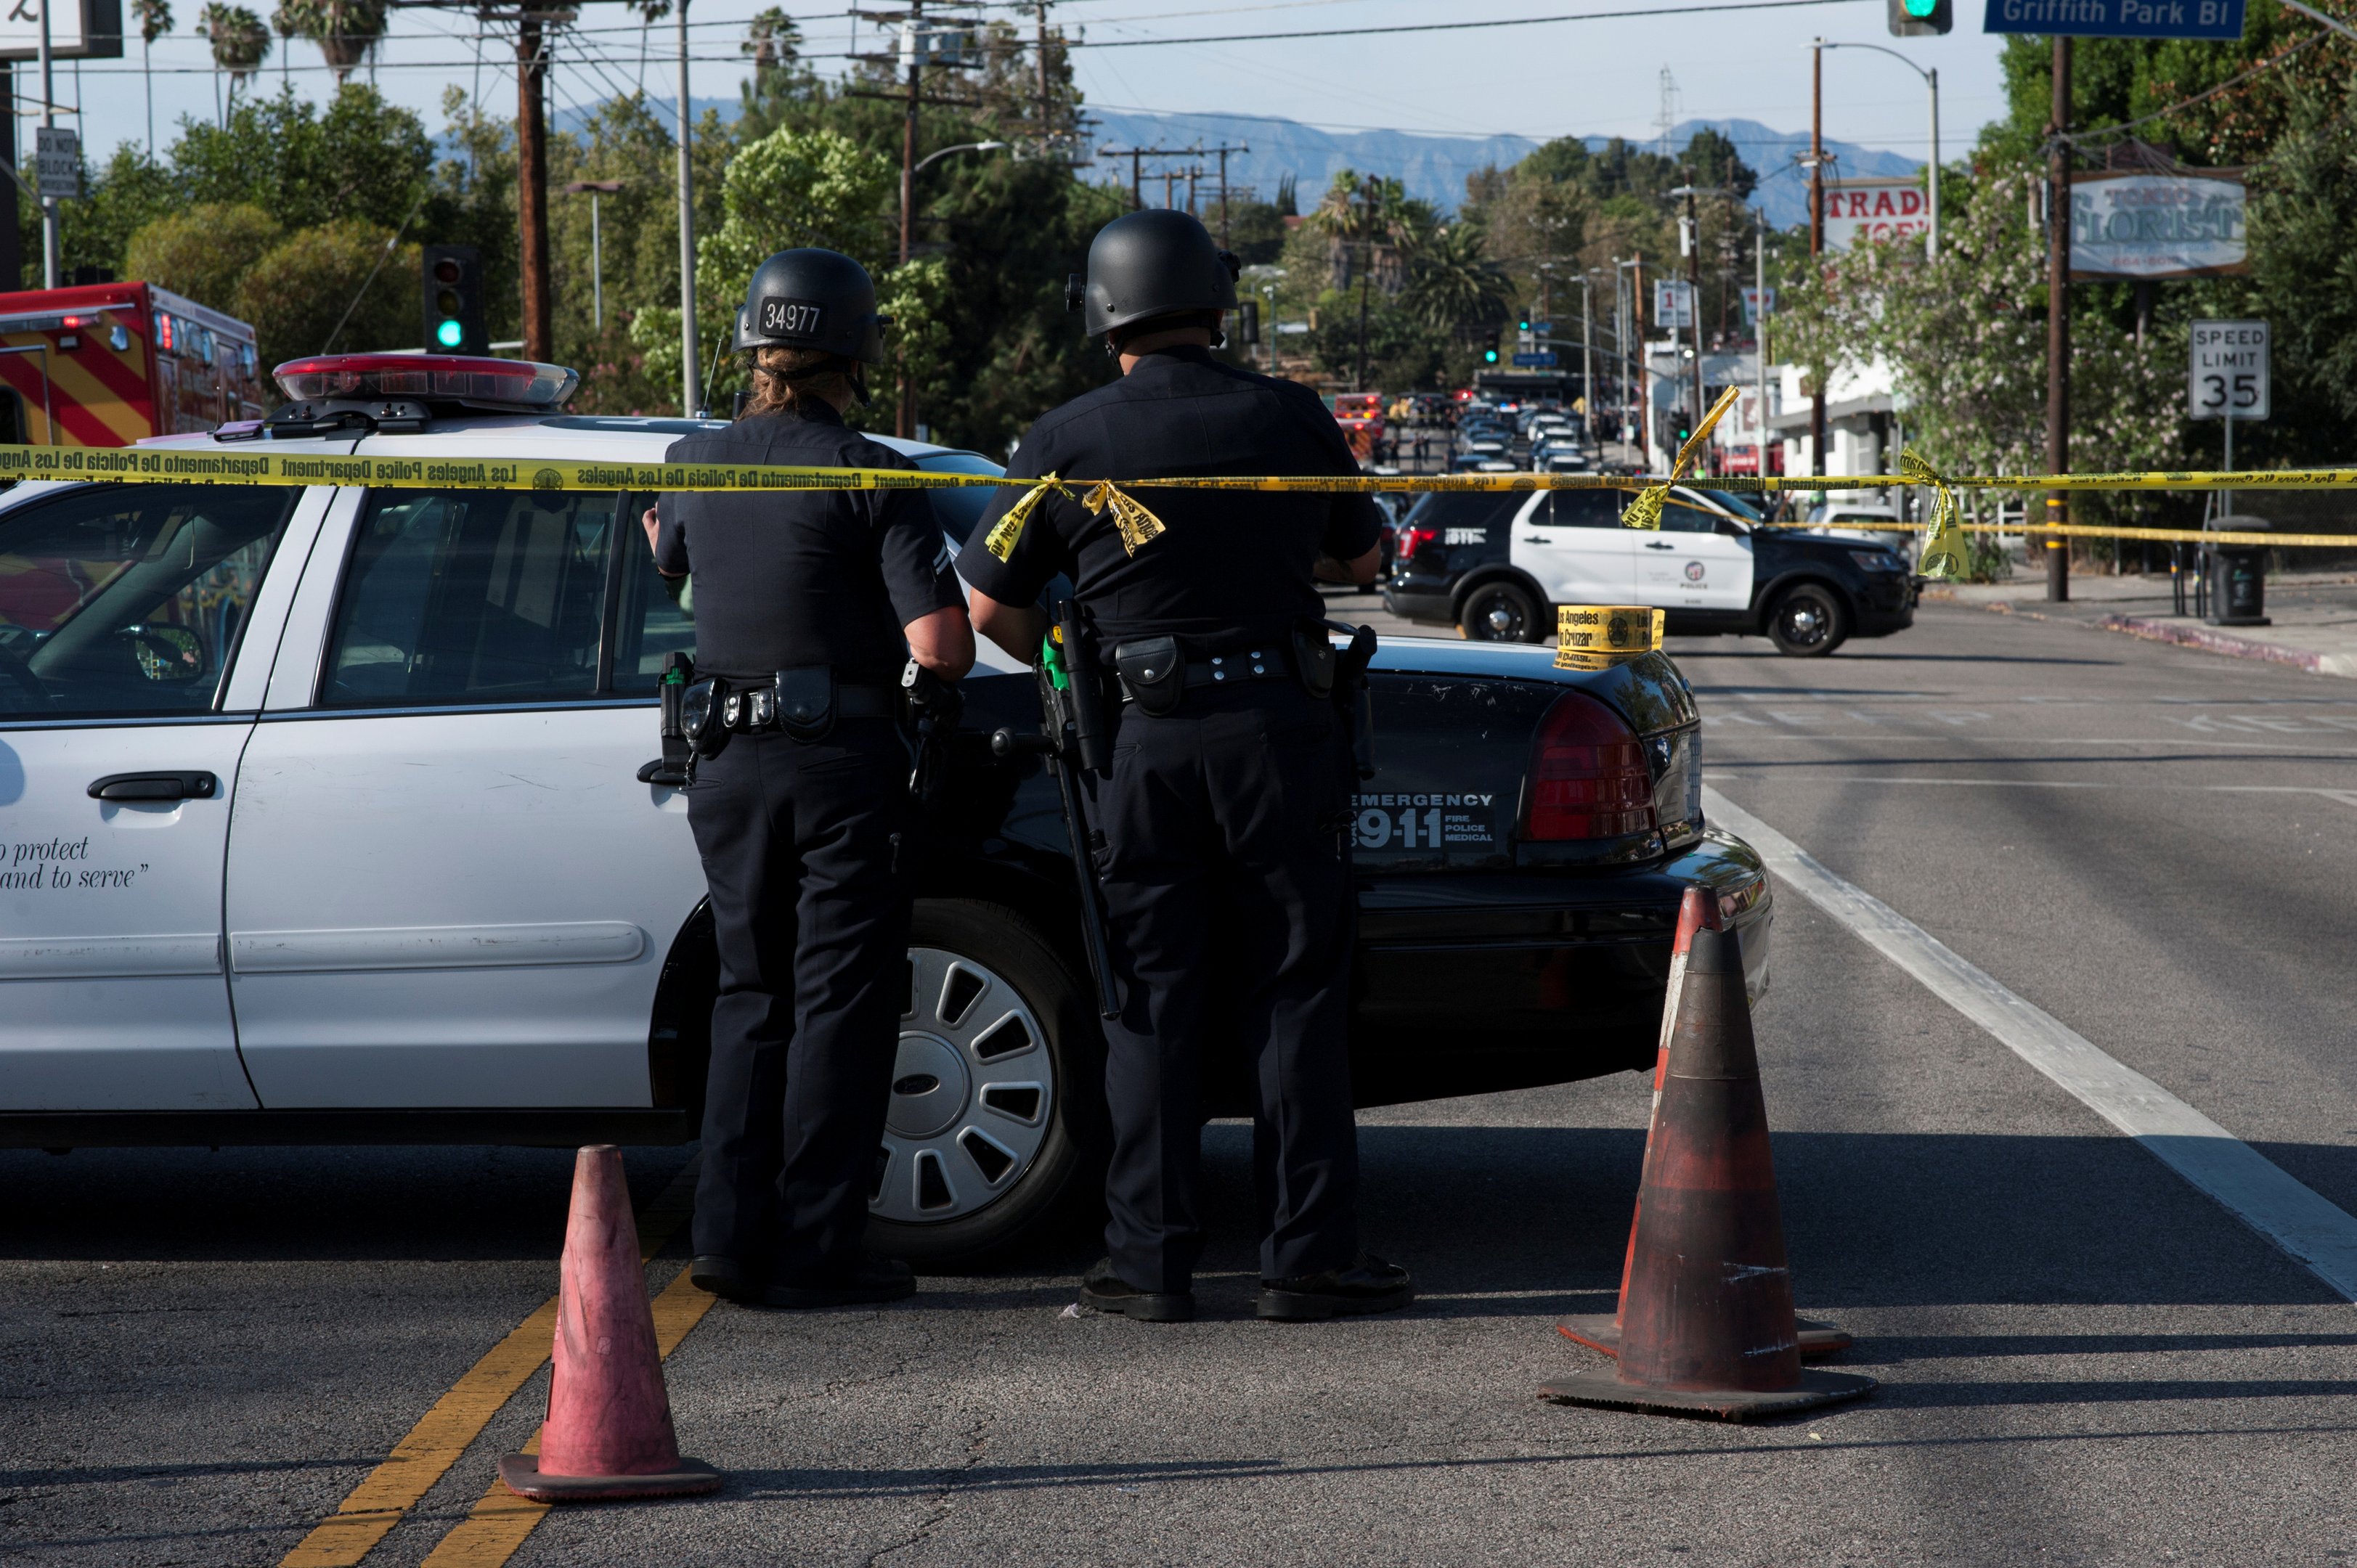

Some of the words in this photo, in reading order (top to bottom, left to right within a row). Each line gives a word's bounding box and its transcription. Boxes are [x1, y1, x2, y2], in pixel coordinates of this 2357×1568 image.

[2003, 0, 2106, 23] Griffith
[2120, 1, 2184, 24] Park
[2199, 2, 2228, 25] Bl
[38, 159, 74, 175] BLOCK
[765, 303, 821, 334] 34977
[2196, 330, 2264, 345] SPEED
[2202, 352, 2257, 367] LIMIT
[2202, 375, 2258, 407] 35
[1566, 611, 1599, 626] Angeles
[1566, 629, 1592, 646] Cruzar
[1359, 809, 1441, 848] 9-1-1
[13, 836, 89, 867] protect
[0, 864, 43, 889] and
[52, 865, 71, 889] to
